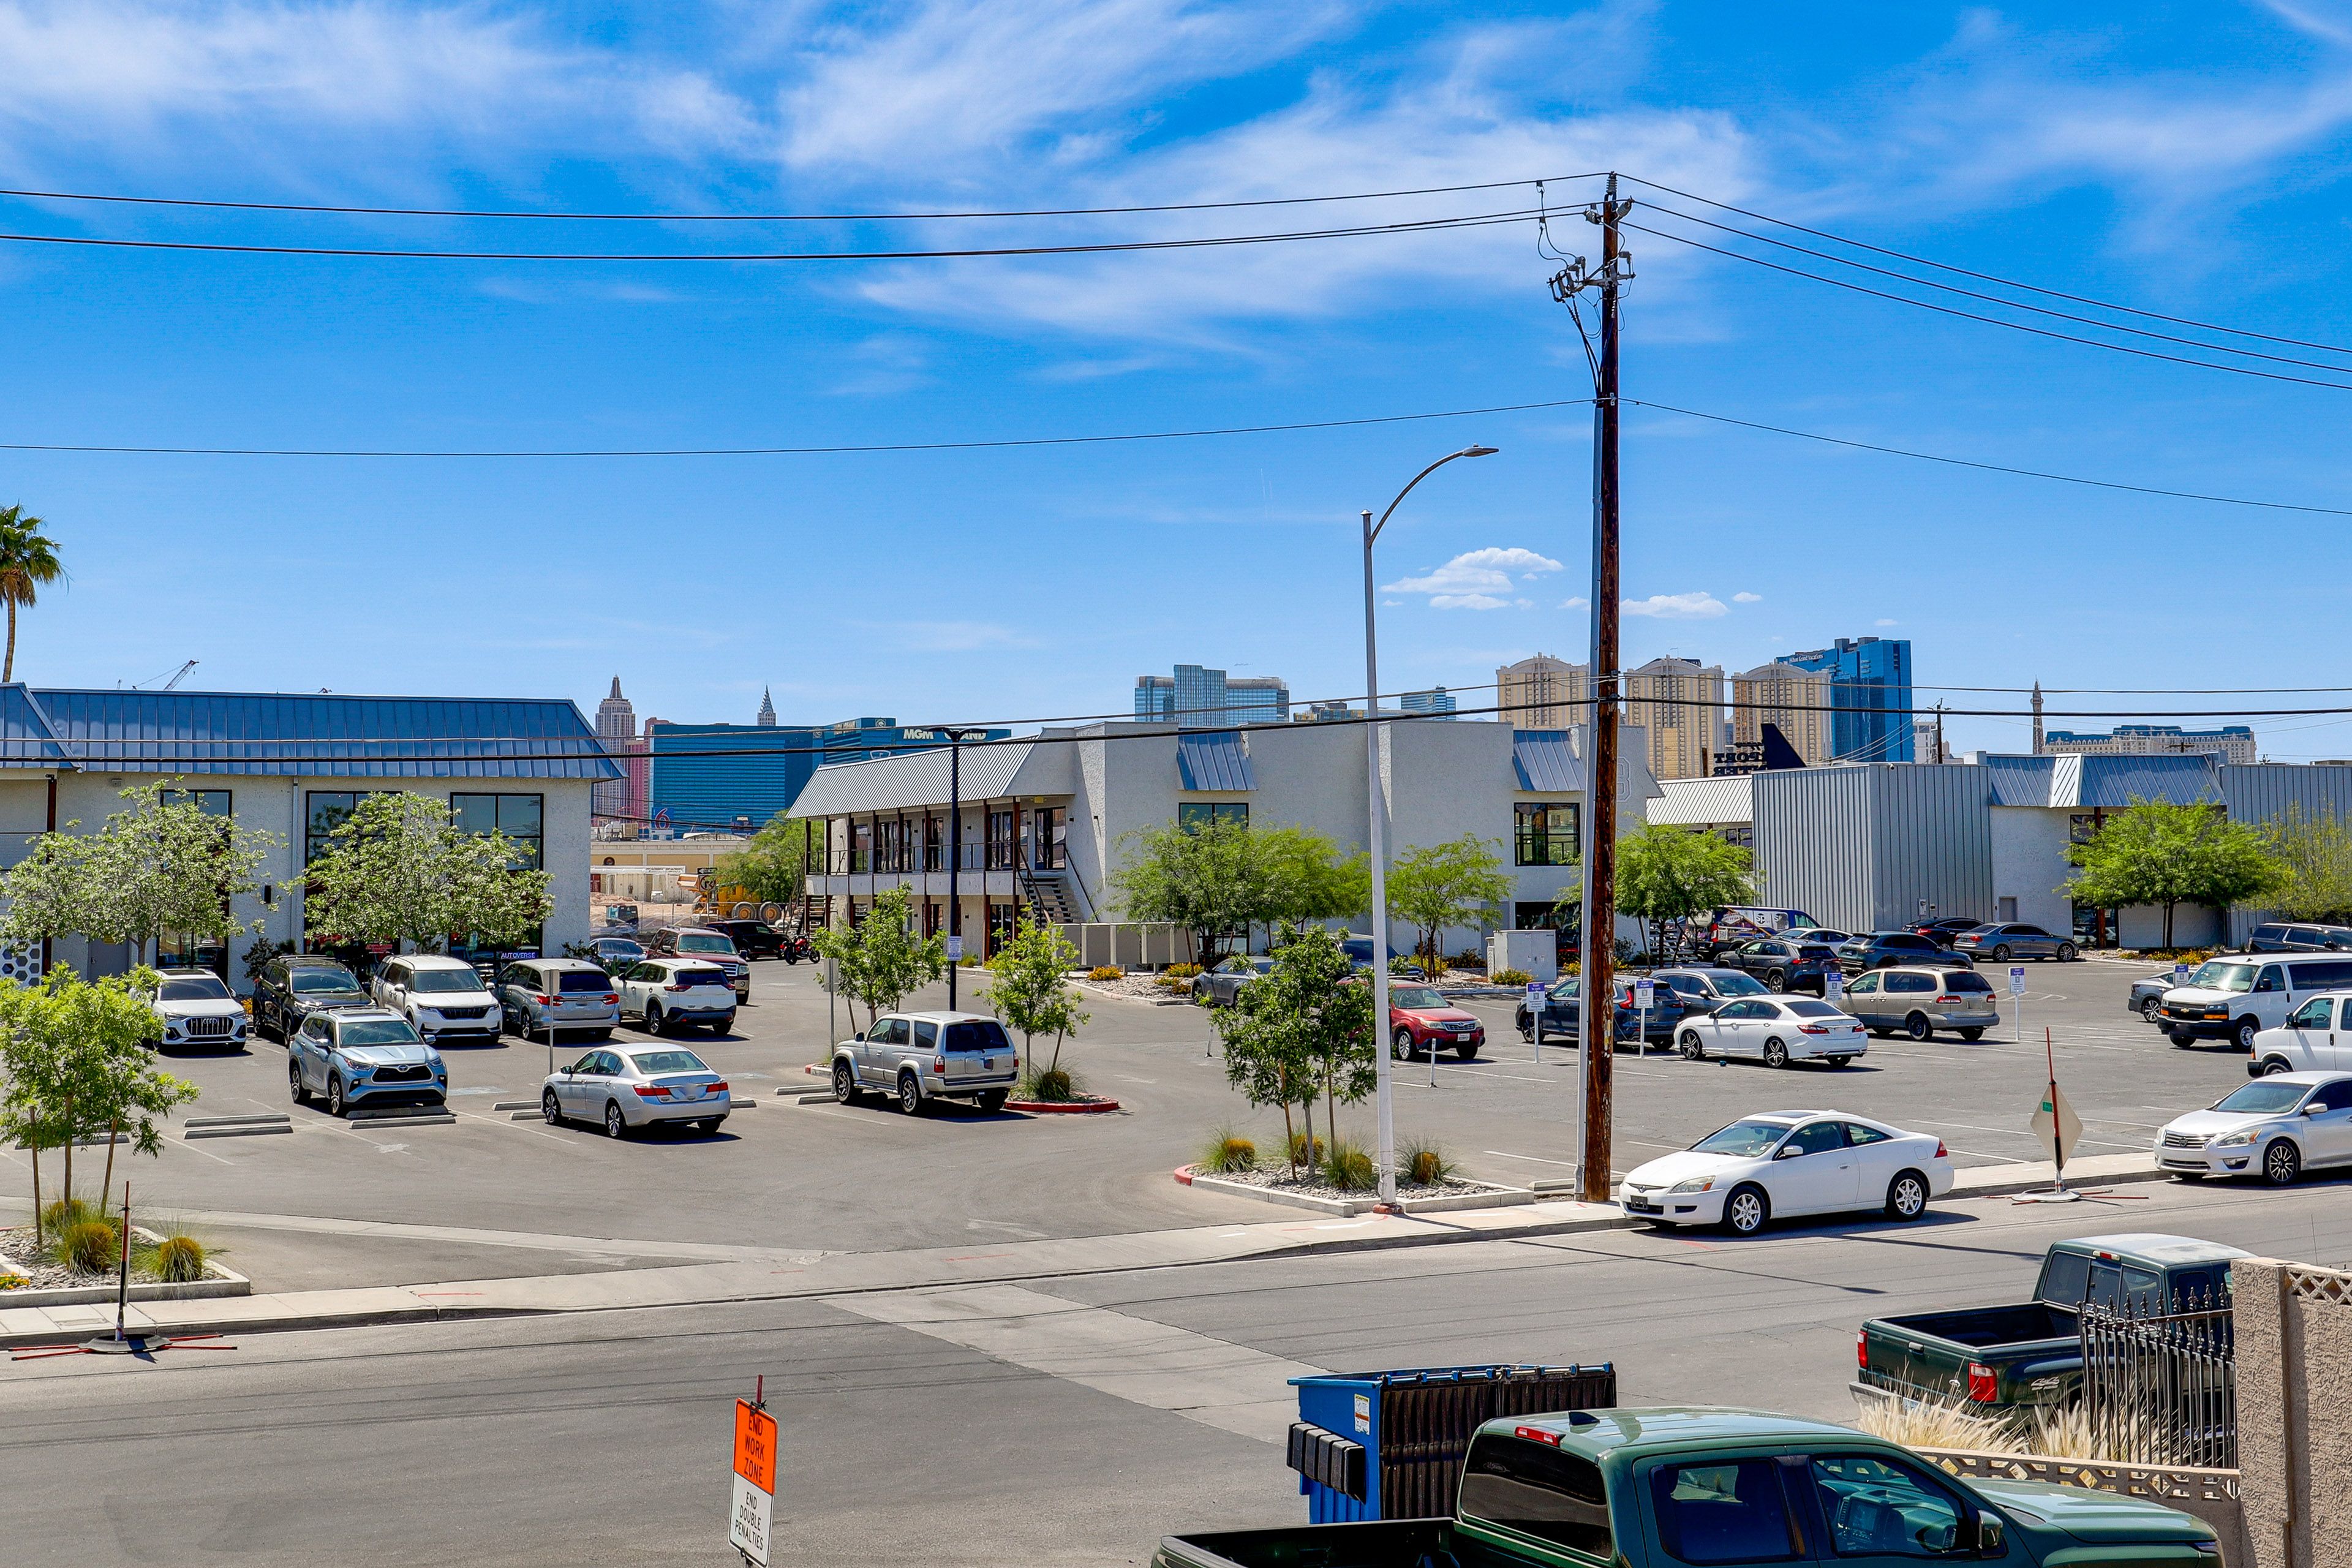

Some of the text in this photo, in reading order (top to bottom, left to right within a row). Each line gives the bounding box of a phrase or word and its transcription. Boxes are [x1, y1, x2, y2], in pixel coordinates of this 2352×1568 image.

[903, 729, 934, 740] MGM
[655, 808, 670, 829] 6
[748, 1414, 763, 1436] END
[745, 1434, 765, 1462] WORK
[744, 1457, 763, 1484] ZONE
[746, 1491, 758, 1510] END
[739, 1504, 761, 1531] DOUBLE
[734, 1519, 764, 1551] PENALTIES
